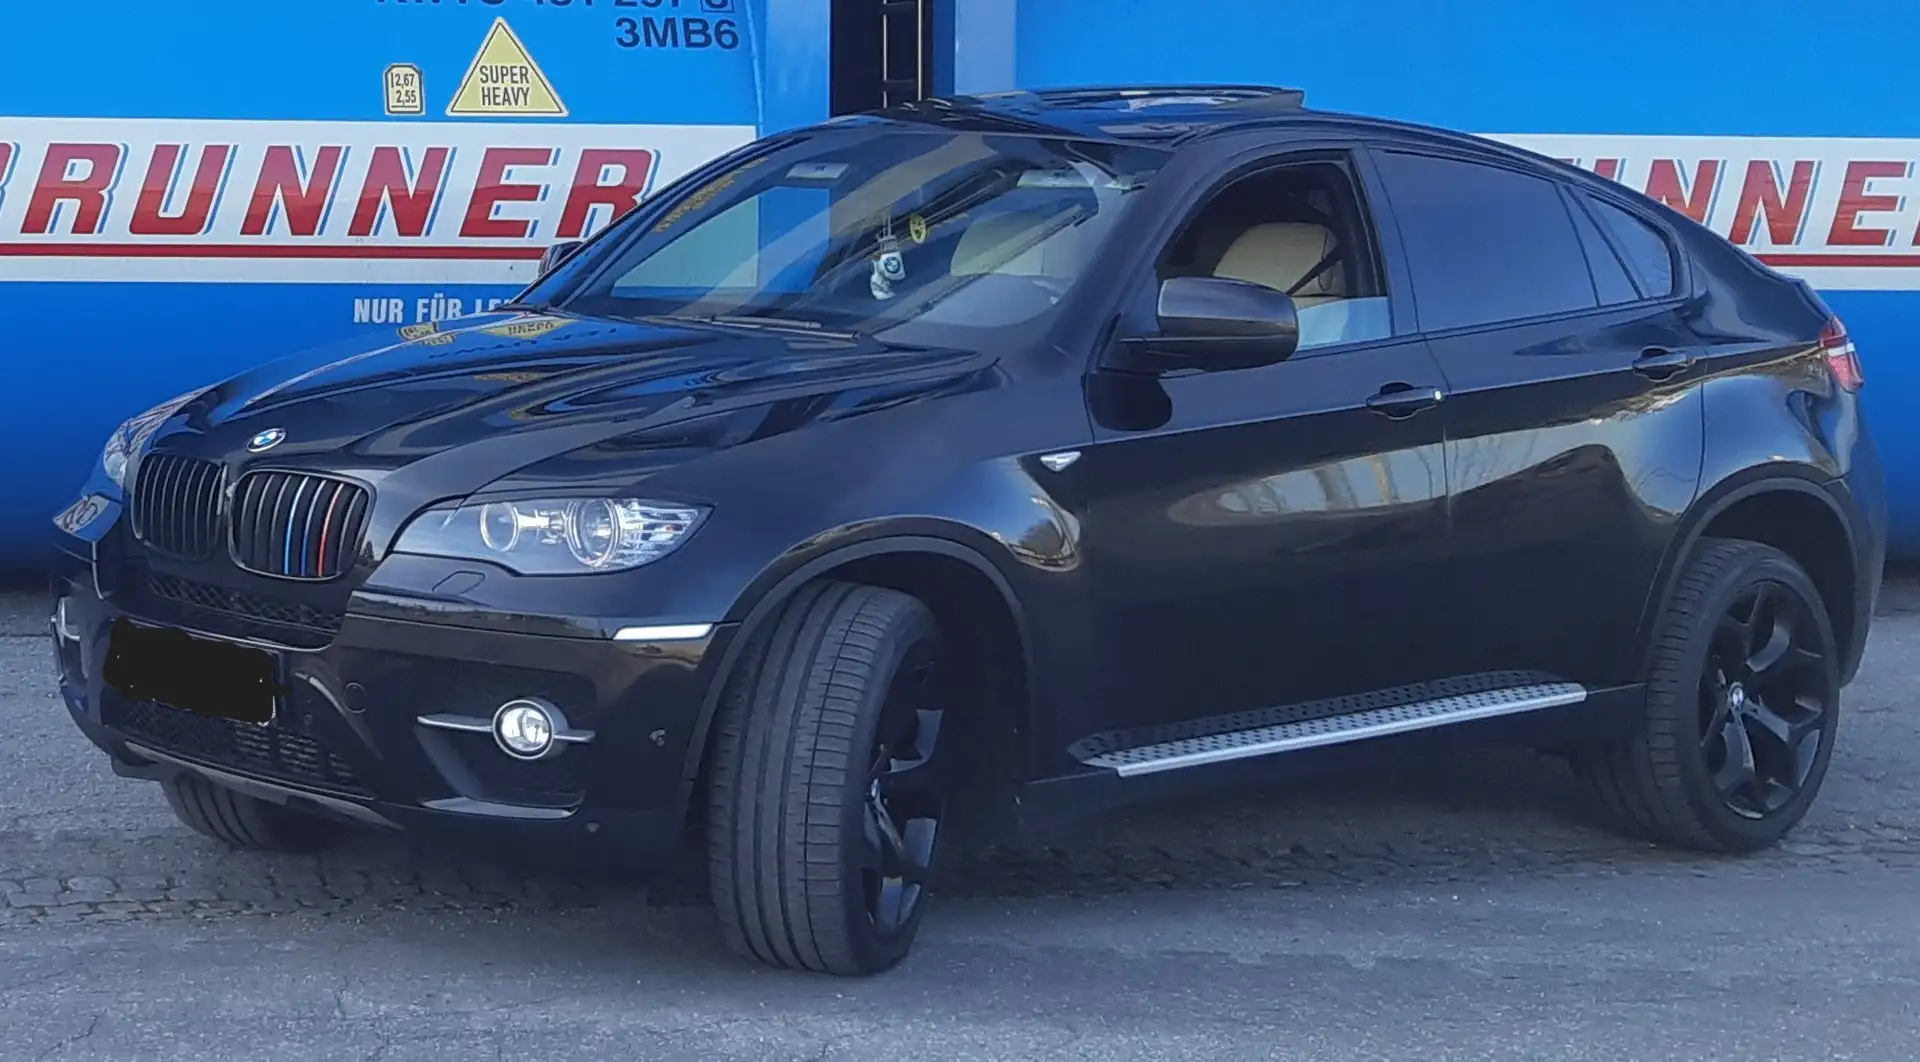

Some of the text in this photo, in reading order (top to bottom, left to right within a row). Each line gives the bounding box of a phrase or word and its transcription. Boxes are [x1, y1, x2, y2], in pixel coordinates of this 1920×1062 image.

[615, 17, 739, 49] 3MB6
[480, 65, 530, 84] SUPER
[396, 90, 417, 105] 2,55
[481, 87, 530, 106] HEAVY
[0, 141, 661, 239] RUNNER
[353, 298, 404, 324] NUR
[415, 292, 463, 323] FÜR
